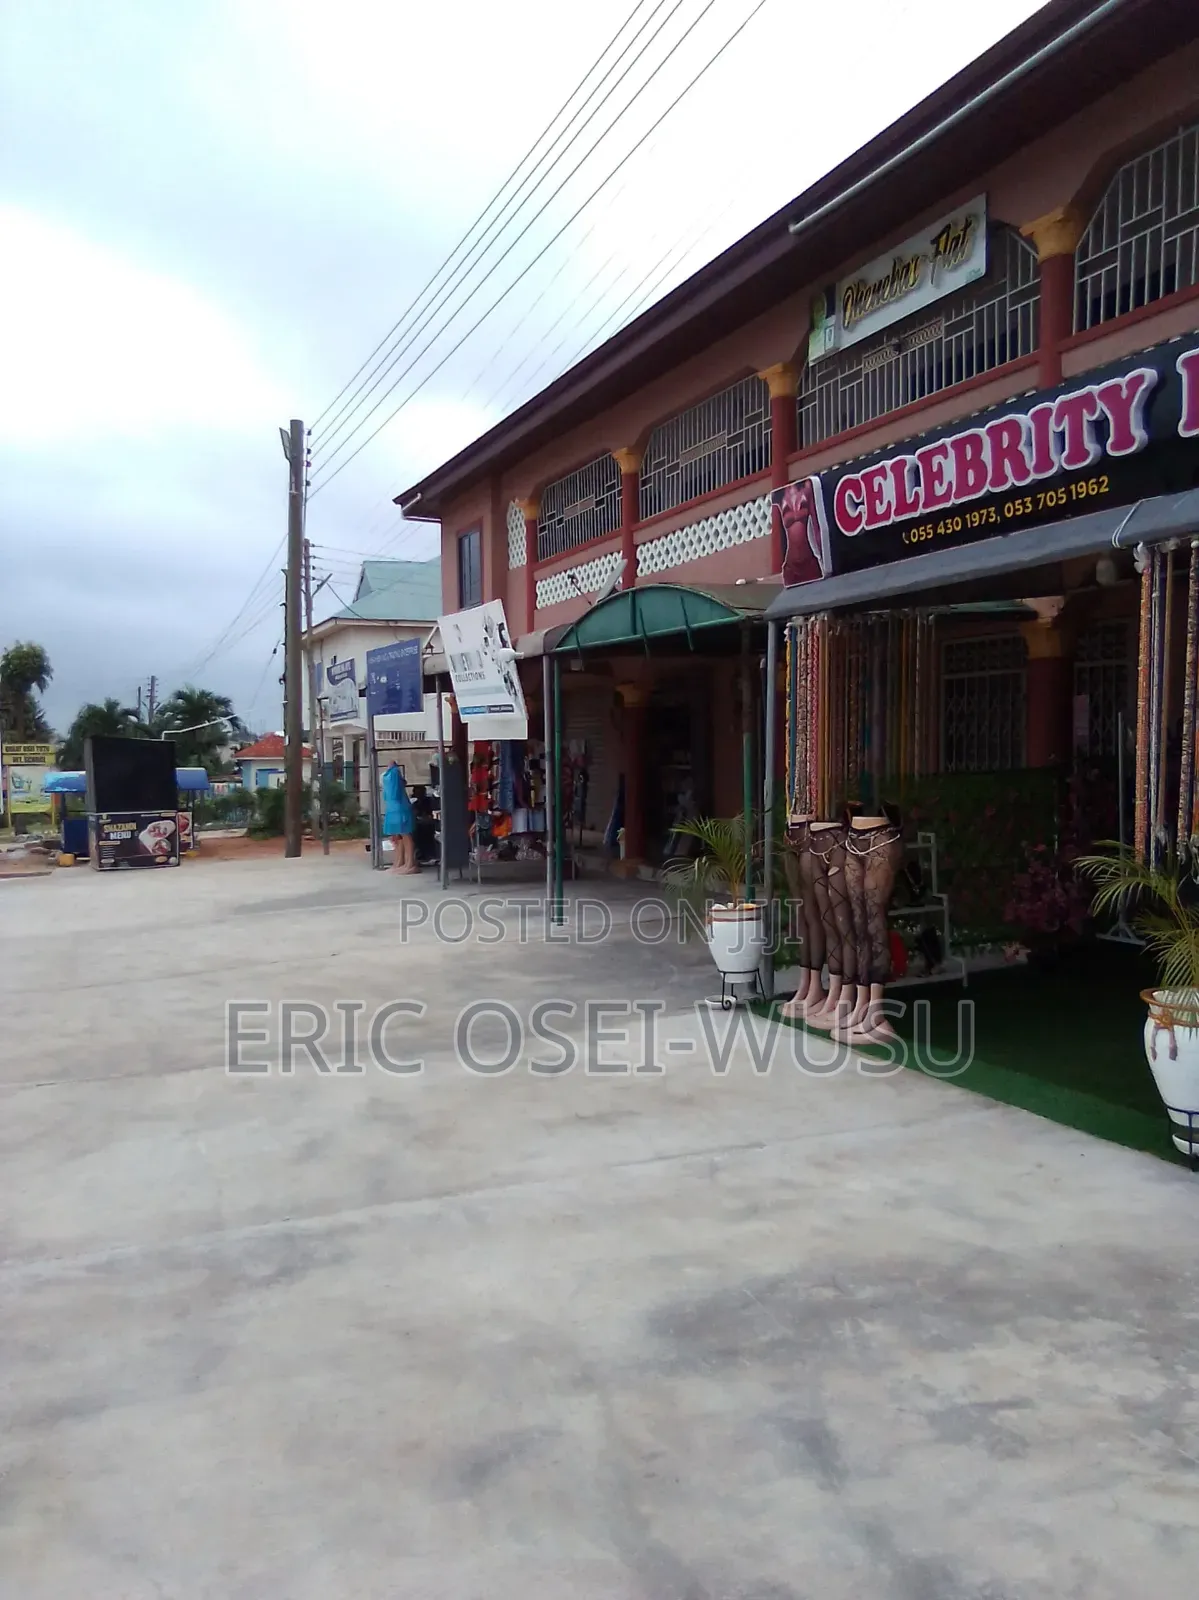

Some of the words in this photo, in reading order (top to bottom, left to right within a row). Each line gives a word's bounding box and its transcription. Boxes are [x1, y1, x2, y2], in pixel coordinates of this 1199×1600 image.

[834, 367, 1159, 537] CELEBRITY
[910, 524, 933, 543] 055
[937, 517, 962, 535] 430
[966, 507, 1000, 528] 1973,
[1004, 497, 1033, 518] 053
[1037, 487, 1067, 510] 705
[1070, 475, 1110, 500] 1962
[454, 671, 486, 683] COLLECTIONS
